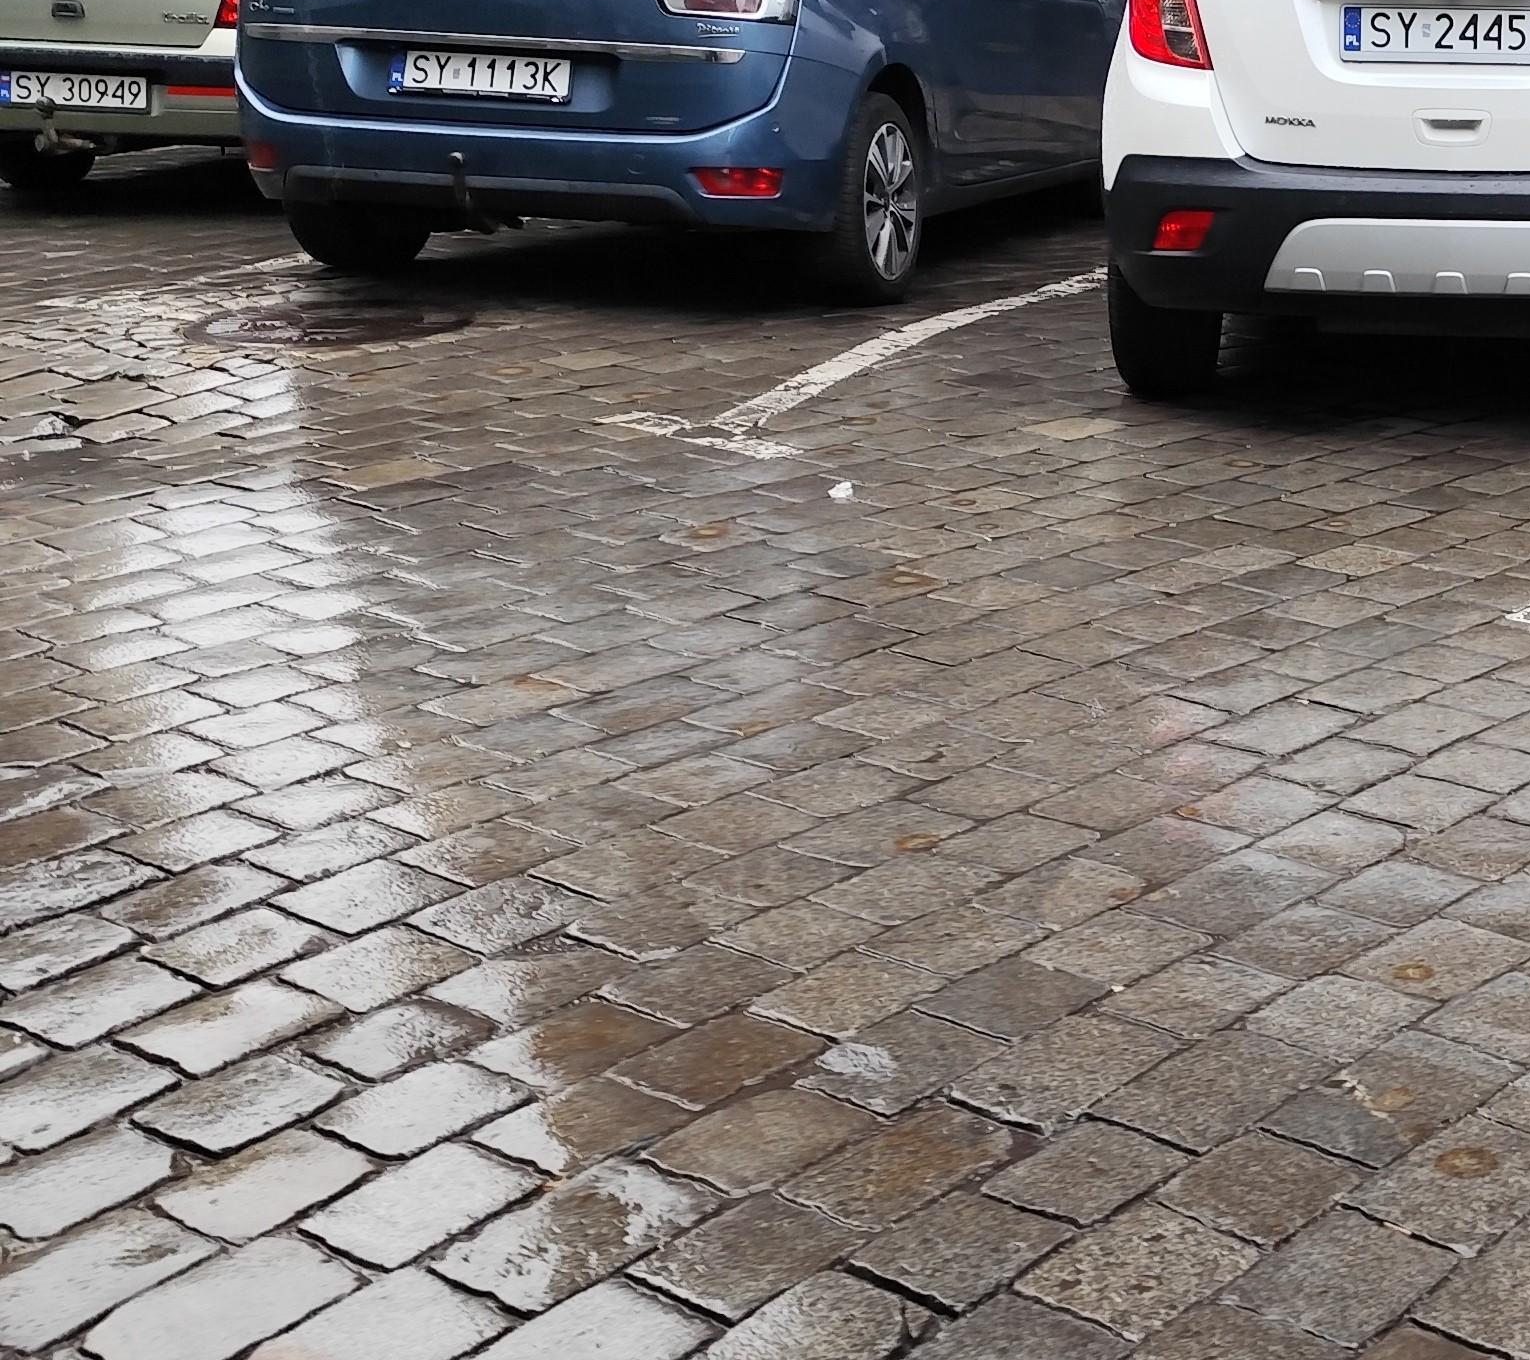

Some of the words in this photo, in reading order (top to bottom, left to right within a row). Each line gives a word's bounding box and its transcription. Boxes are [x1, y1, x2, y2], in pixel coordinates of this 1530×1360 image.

[1345, 34, 1360, 46] PL
[1370, 11, 1417, 49] SY
[411, 54, 452, 86] SY
[467, 56, 561, 92] 1113K
[15, 74, 51, 100] SY
[62, 77, 142, 106] 30949
[1265, 116, 1316, 128] MOKKA
